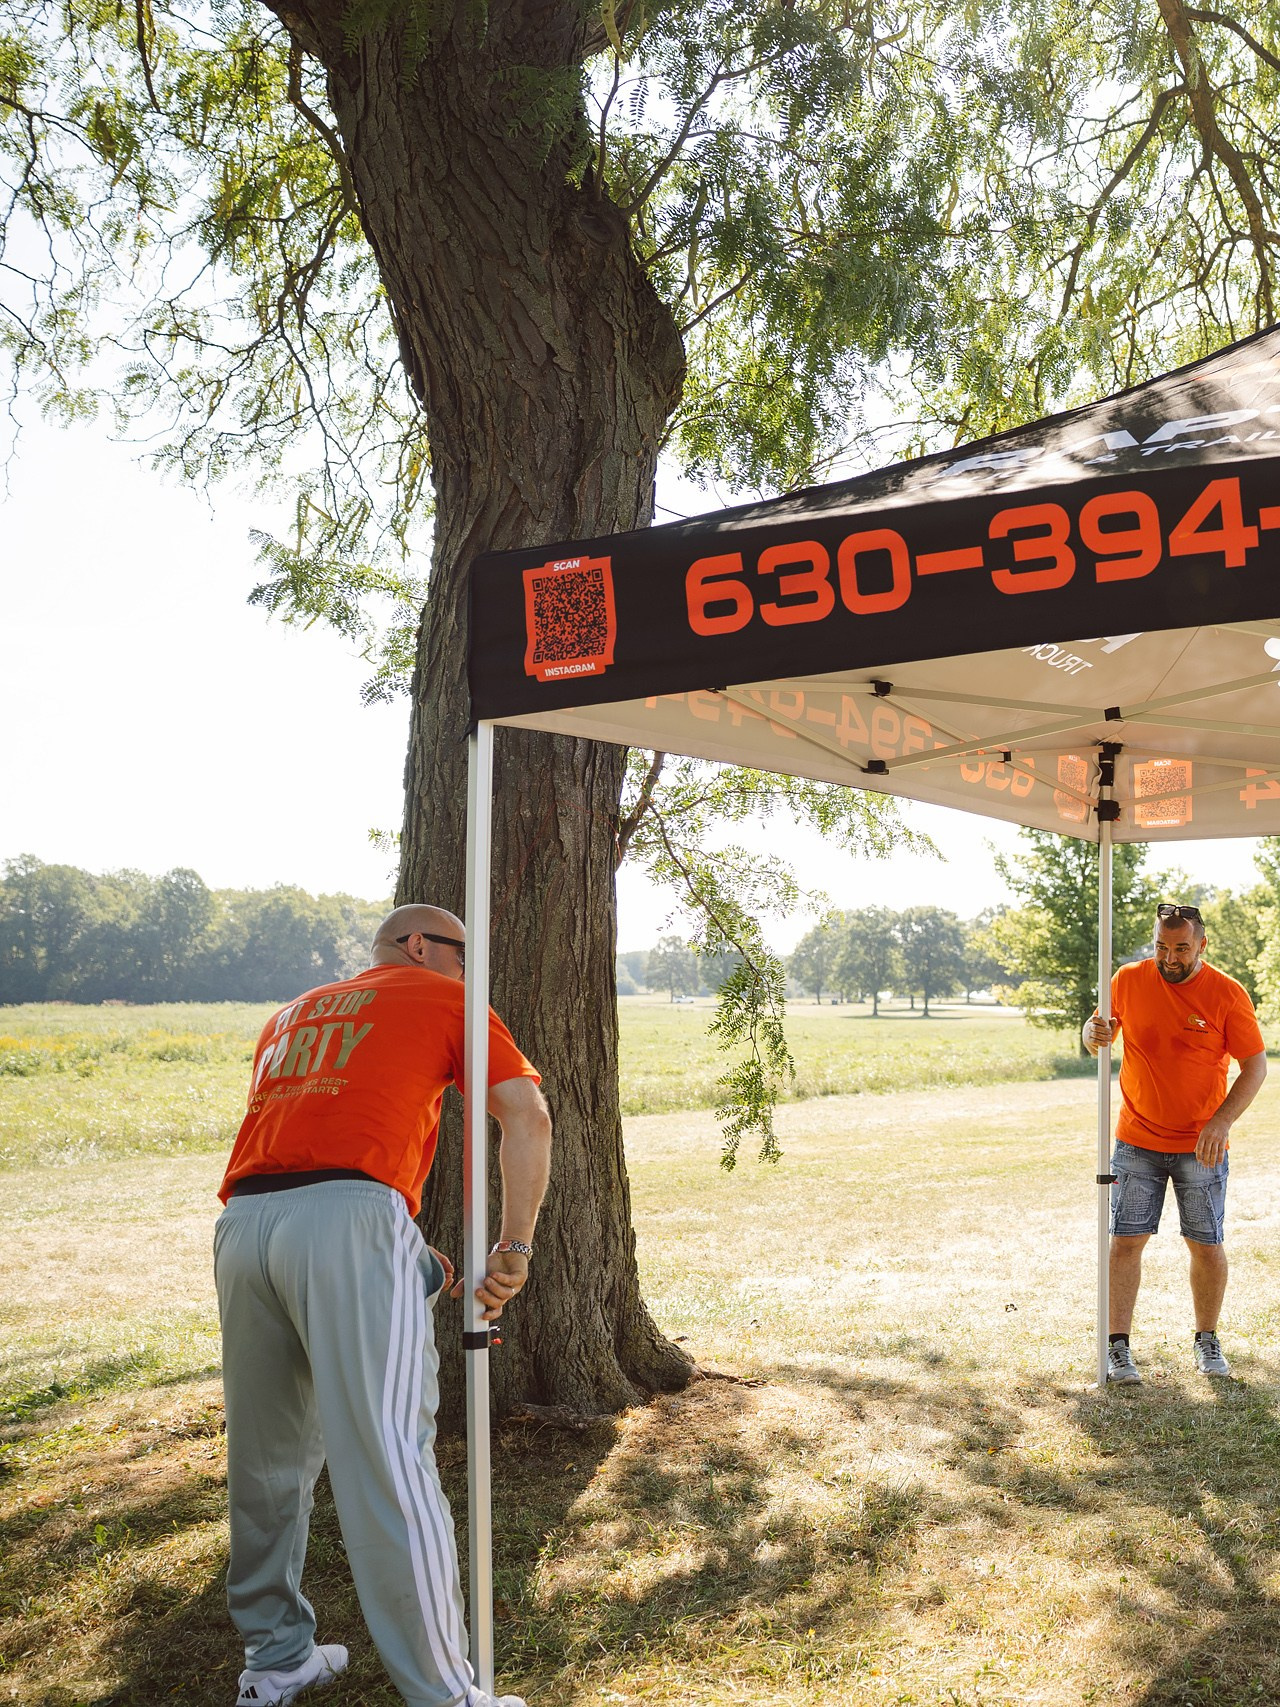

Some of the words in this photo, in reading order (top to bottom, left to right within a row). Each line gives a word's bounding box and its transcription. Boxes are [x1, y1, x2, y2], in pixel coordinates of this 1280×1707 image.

[553, 559, 580, 572] SCAN
[544, 662, 596, 677] INSTAGRAM
[274, 999, 311, 1037] PIT
[307, 989, 378, 1020] STOP
[255, 1021, 375, 1095] PARTY
[320, 1077, 349, 1087] REST
